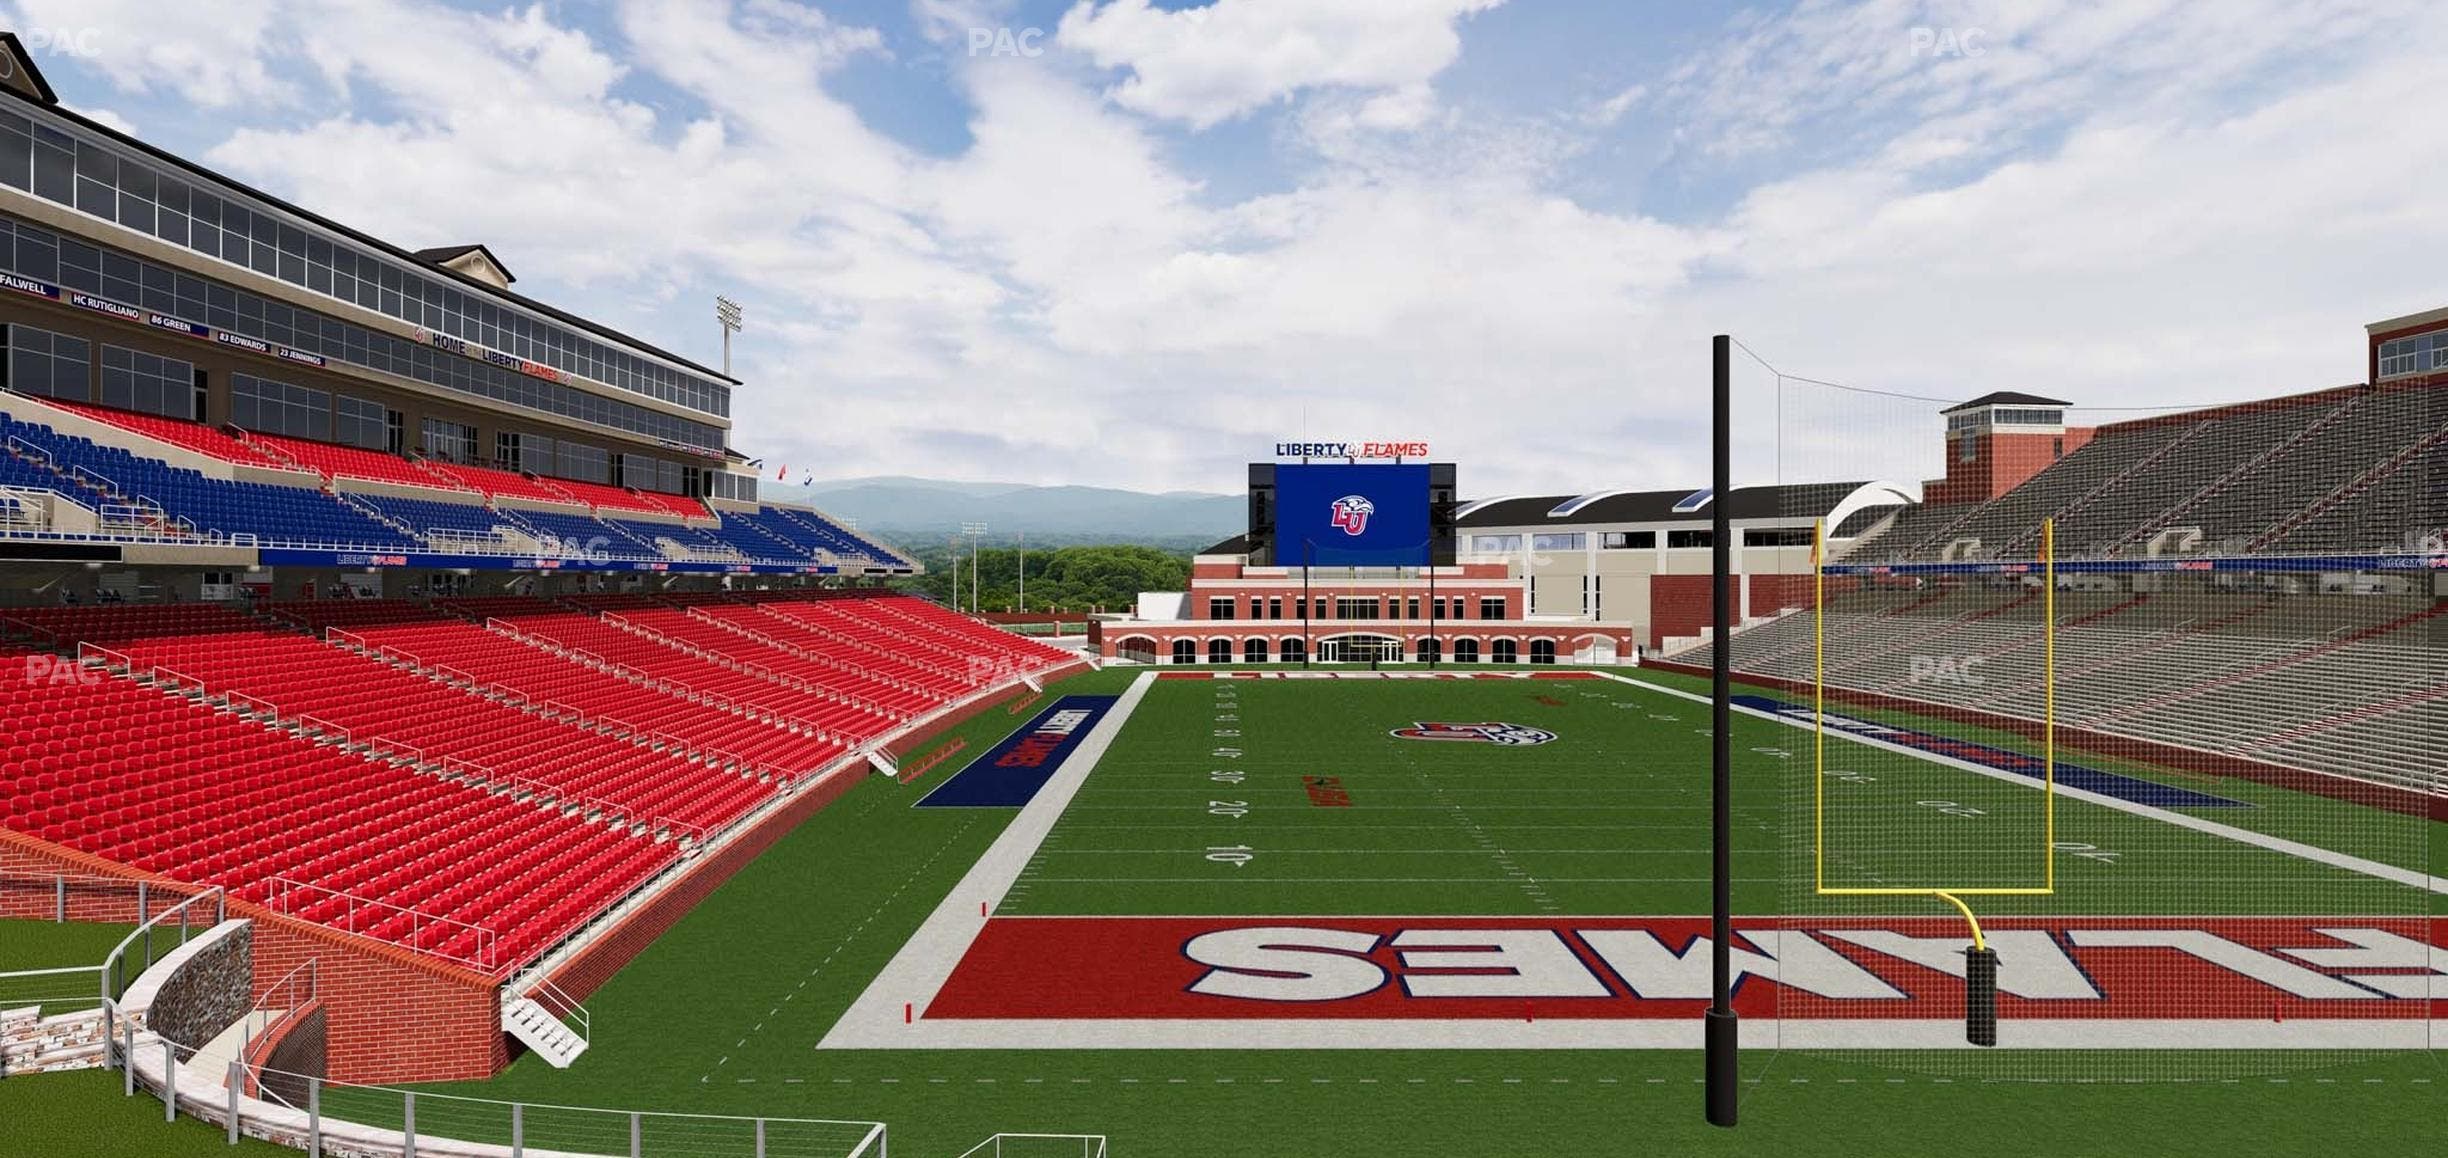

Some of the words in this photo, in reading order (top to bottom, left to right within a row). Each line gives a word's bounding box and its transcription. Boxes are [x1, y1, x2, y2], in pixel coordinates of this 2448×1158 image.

[73, 294, 87, 306] HC
[88, 297, 139, 318] RUTIGLIANO
[151, 314, 162, 324] 86
[163, 318, 191, 332] GREEN
[230, 335, 266, 351] EDWARDS
[432, 333, 466, 354] HOME
[289, 351, 321, 365] JENNINGS
[1276, 443, 1347, 456] LIBERTY
[1363, 443, 1428, 456] FLAMES
[1331, 502, 1369, 536] LU
[1205, 844, 1254, 862] 10
